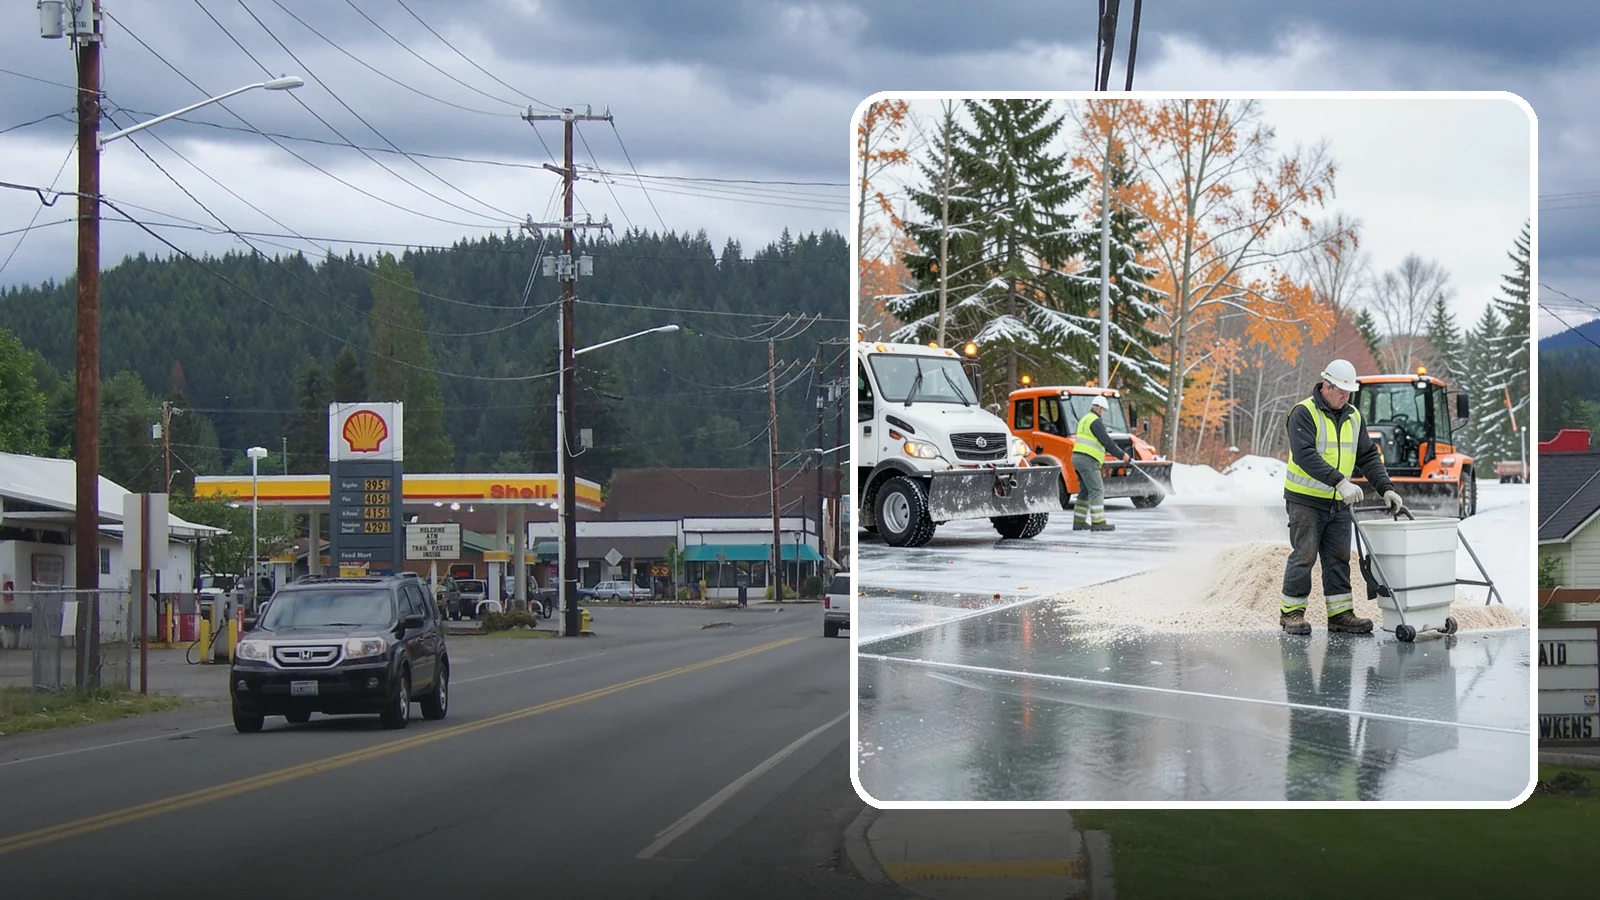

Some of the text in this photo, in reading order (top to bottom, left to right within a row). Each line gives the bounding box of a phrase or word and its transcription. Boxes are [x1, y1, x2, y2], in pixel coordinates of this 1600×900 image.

[366, 480, 383, 490] 395
[490, 484, 547, 499] Shell
[366, 494, 383, 504] 405
[366, 508, 383, 518] 415
[366, 522, 383, 532] 429
